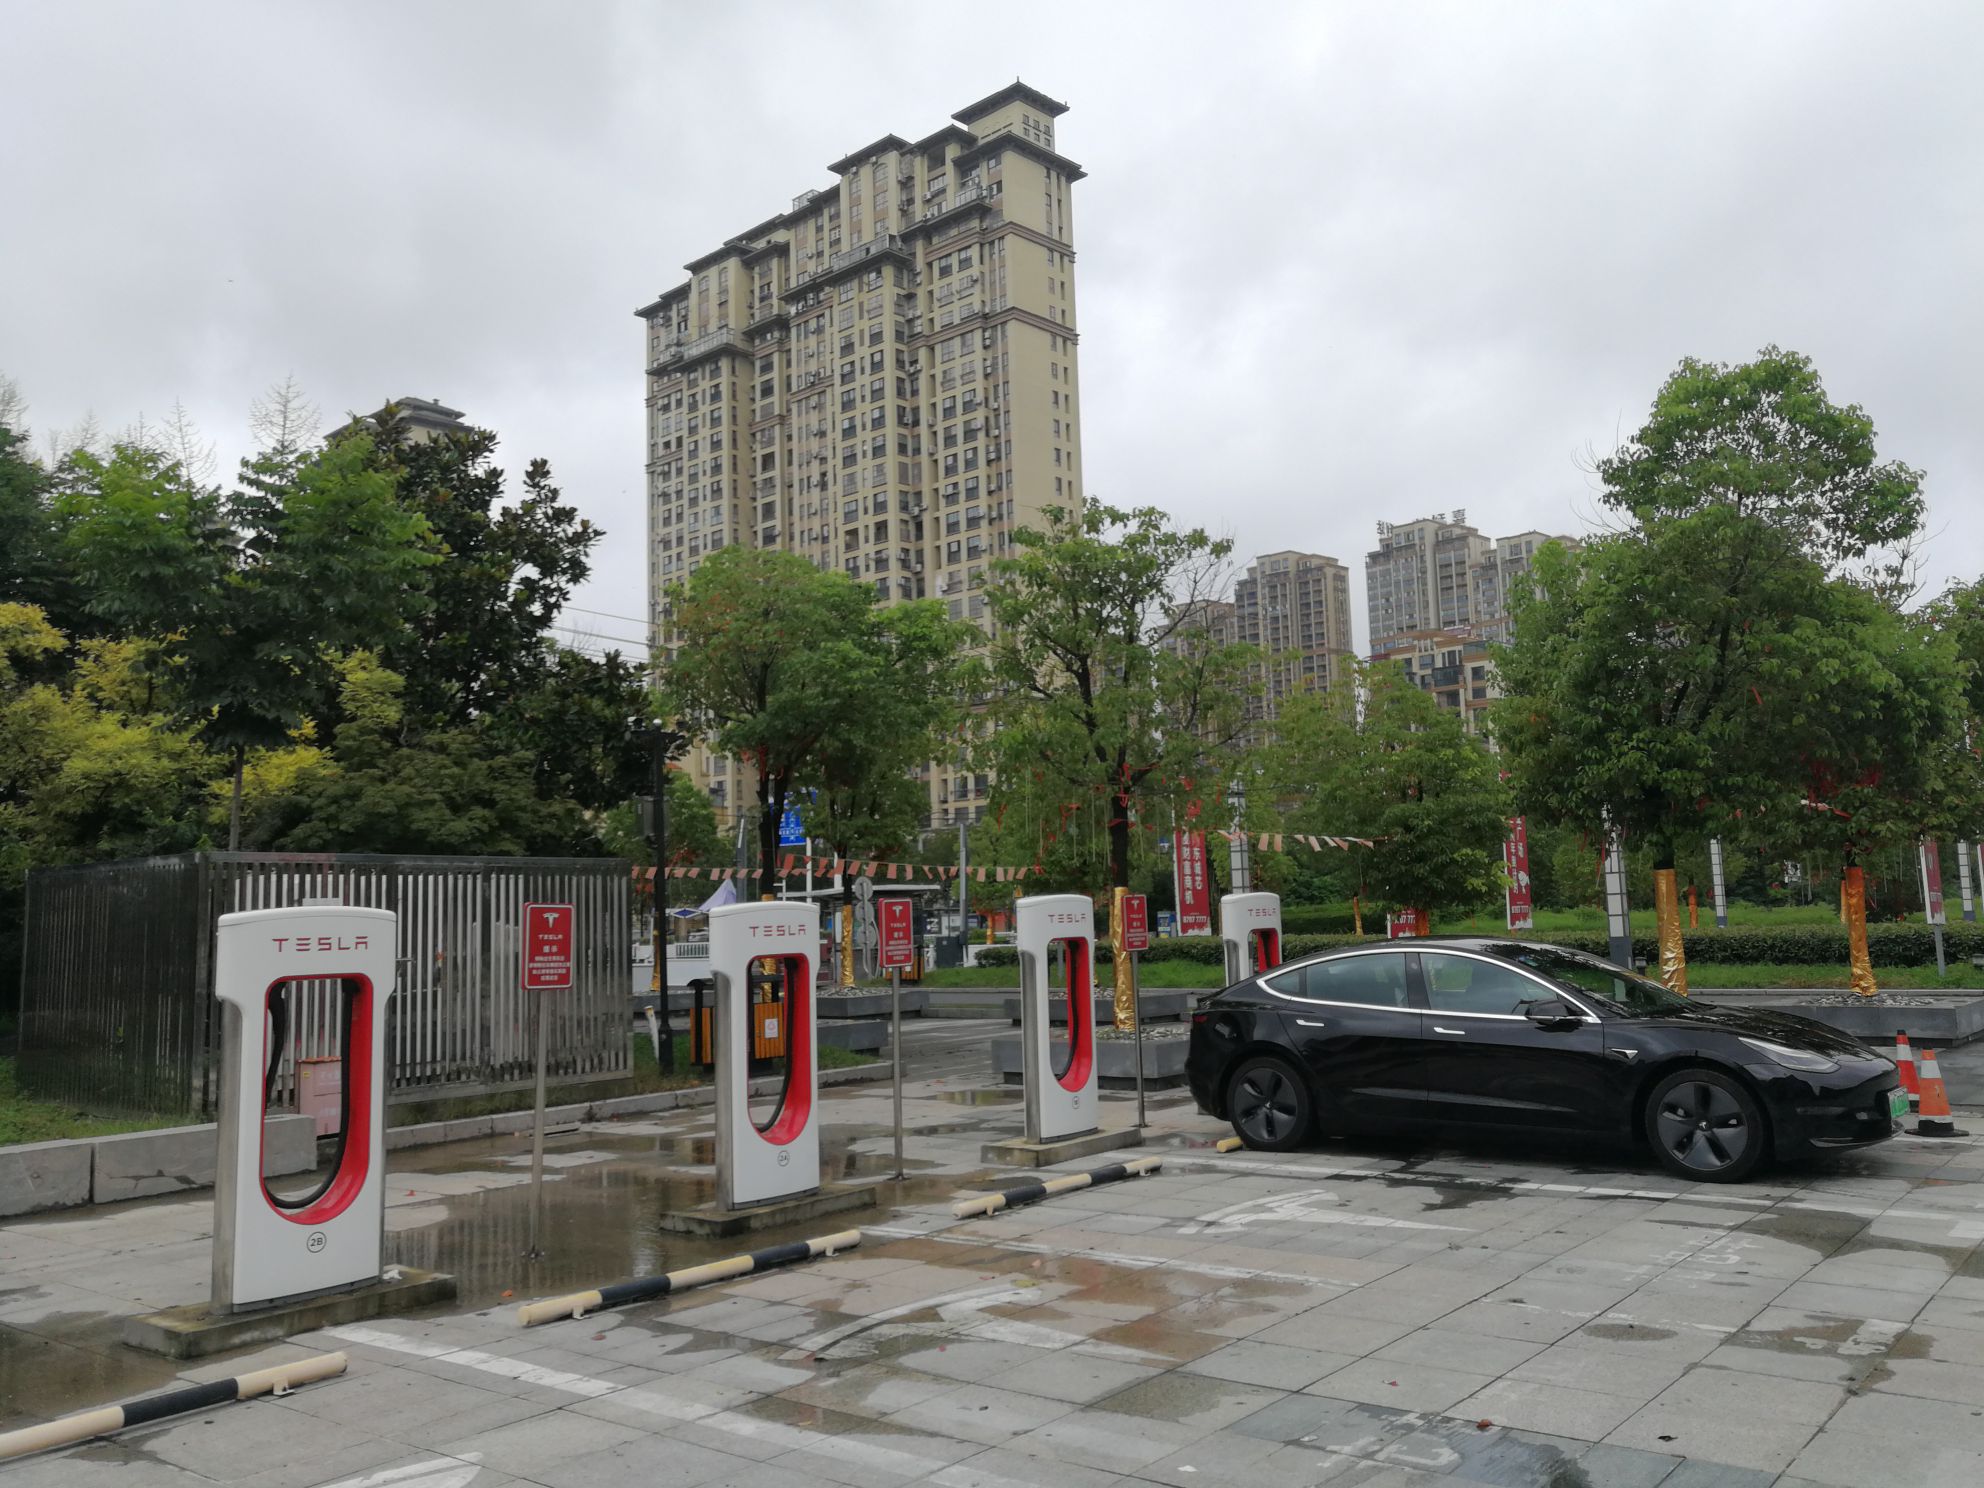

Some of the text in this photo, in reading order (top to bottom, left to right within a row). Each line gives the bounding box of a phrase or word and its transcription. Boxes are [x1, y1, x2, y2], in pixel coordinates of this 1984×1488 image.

[1247, 907, 1277, 917] TESLA
[1048, 913, 1087, 923] TESLA
[748, 924, 807, 938] TESLA
[271, 936, 369, 953] TESLA
[310, 1237, 323, 1247] 2B
